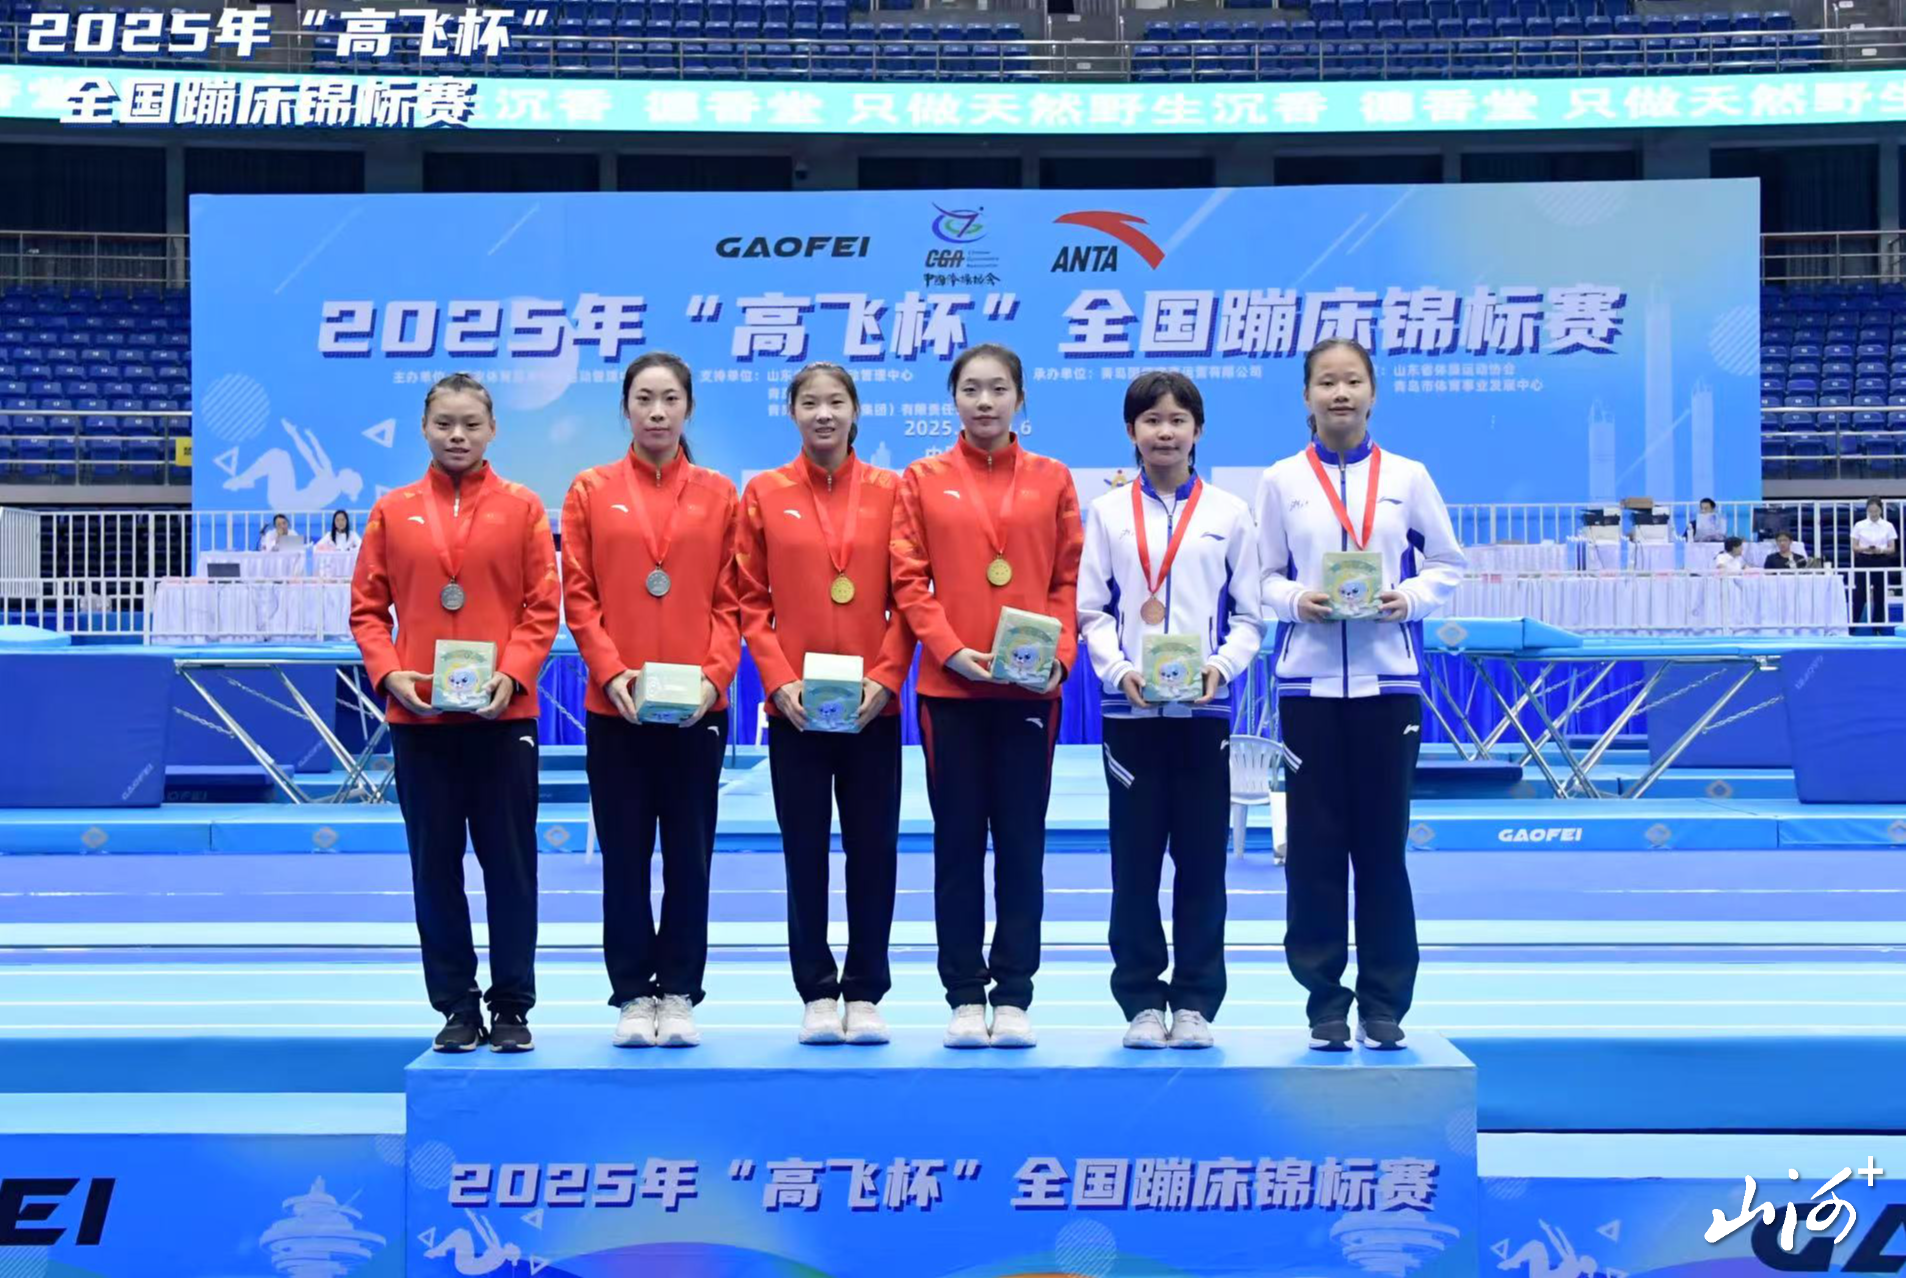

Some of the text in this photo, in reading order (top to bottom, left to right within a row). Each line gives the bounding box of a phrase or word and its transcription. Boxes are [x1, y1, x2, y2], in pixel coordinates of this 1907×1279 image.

[715, 236, 871, 258] GAOFEI
[924, 249, 965, 268] CGA
[1050, 246, 1118, 273] ANTA
[1498, 828, 1582, 842] GAOFEI
